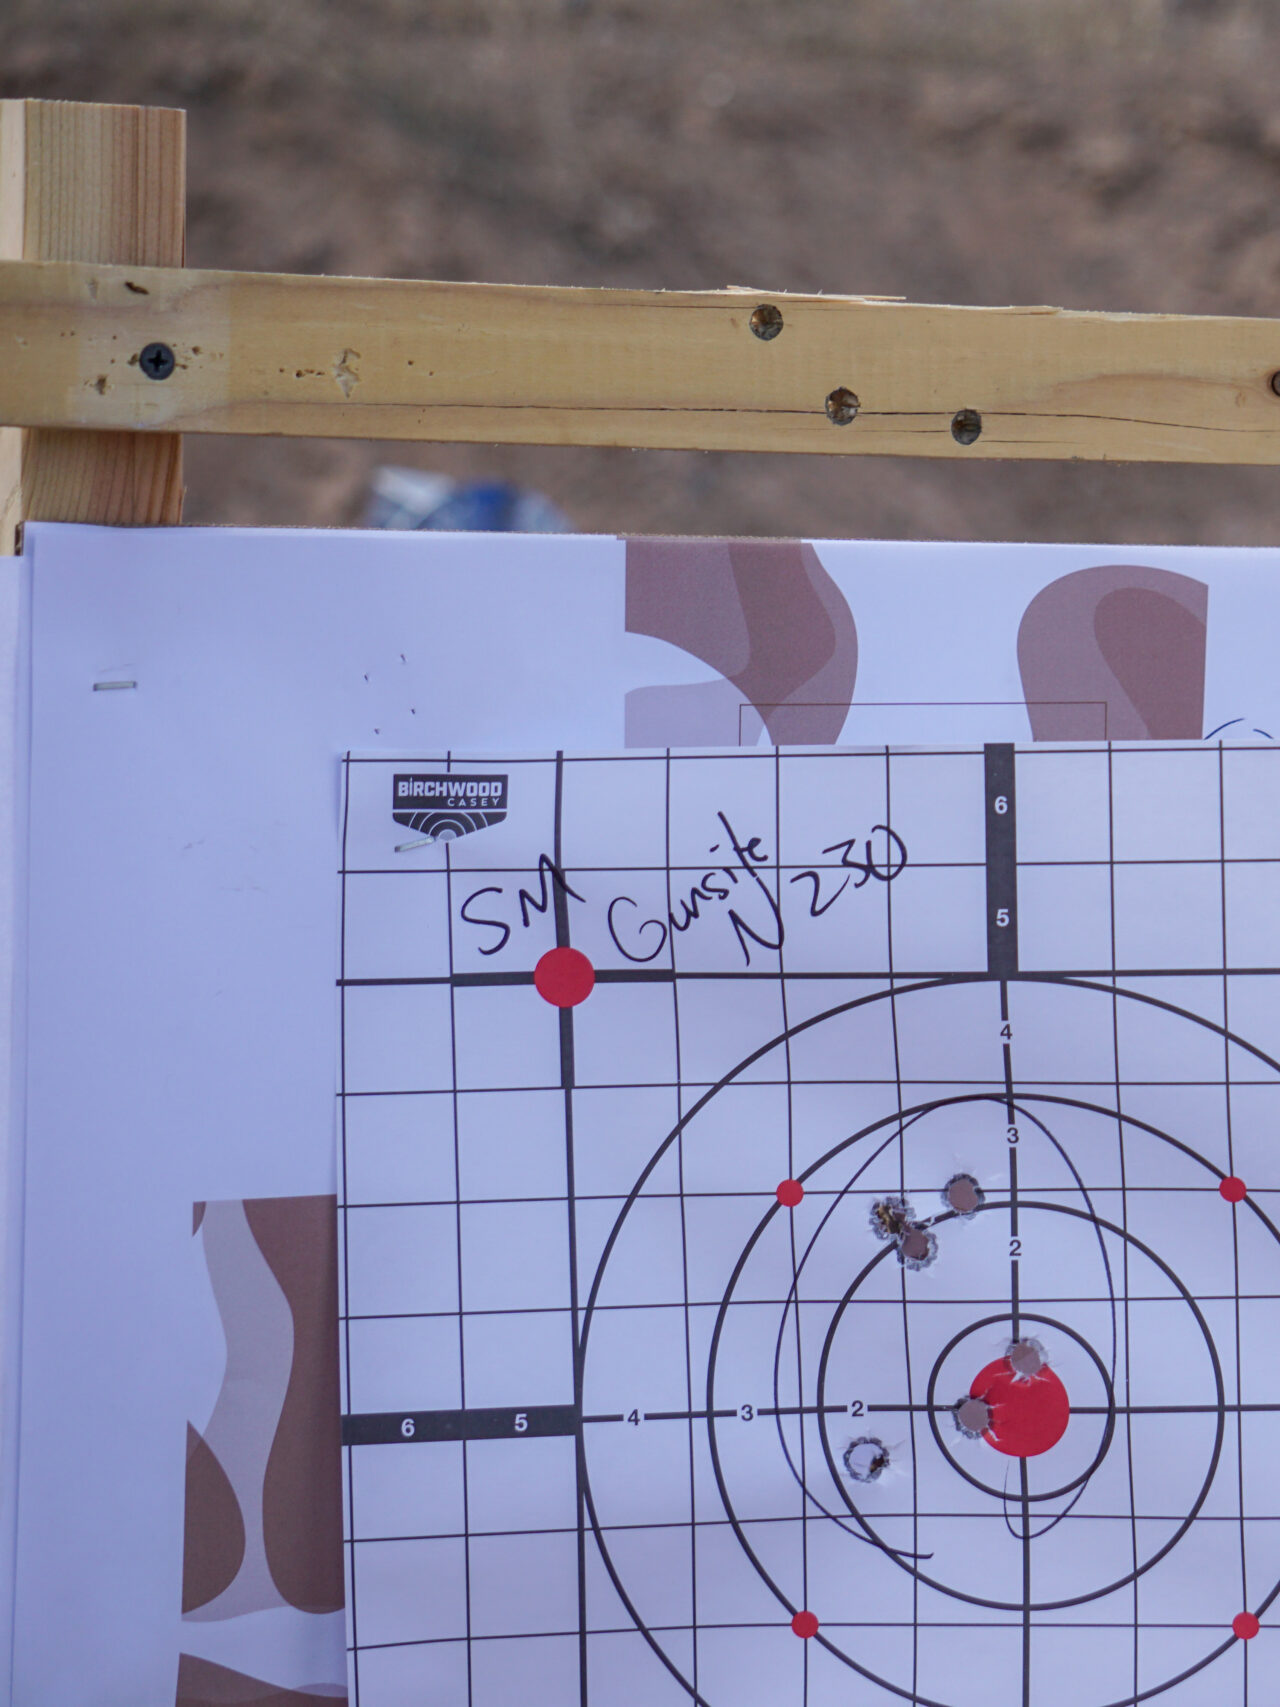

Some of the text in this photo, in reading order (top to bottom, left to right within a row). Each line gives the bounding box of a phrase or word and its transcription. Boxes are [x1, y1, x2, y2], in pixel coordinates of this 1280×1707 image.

[447, 797, 501, 808] CASEY
[994, 796, 1008, 814] 6
[995, 908, 1010, 927] 5
[1000, 1024, 1012, 1040] 4
[1007, 1127, 1019, 1144] 3
[1009, 1239, 1022, 1257] 2
[401, 1400, 864, 1437] 6 5 4 3 2
